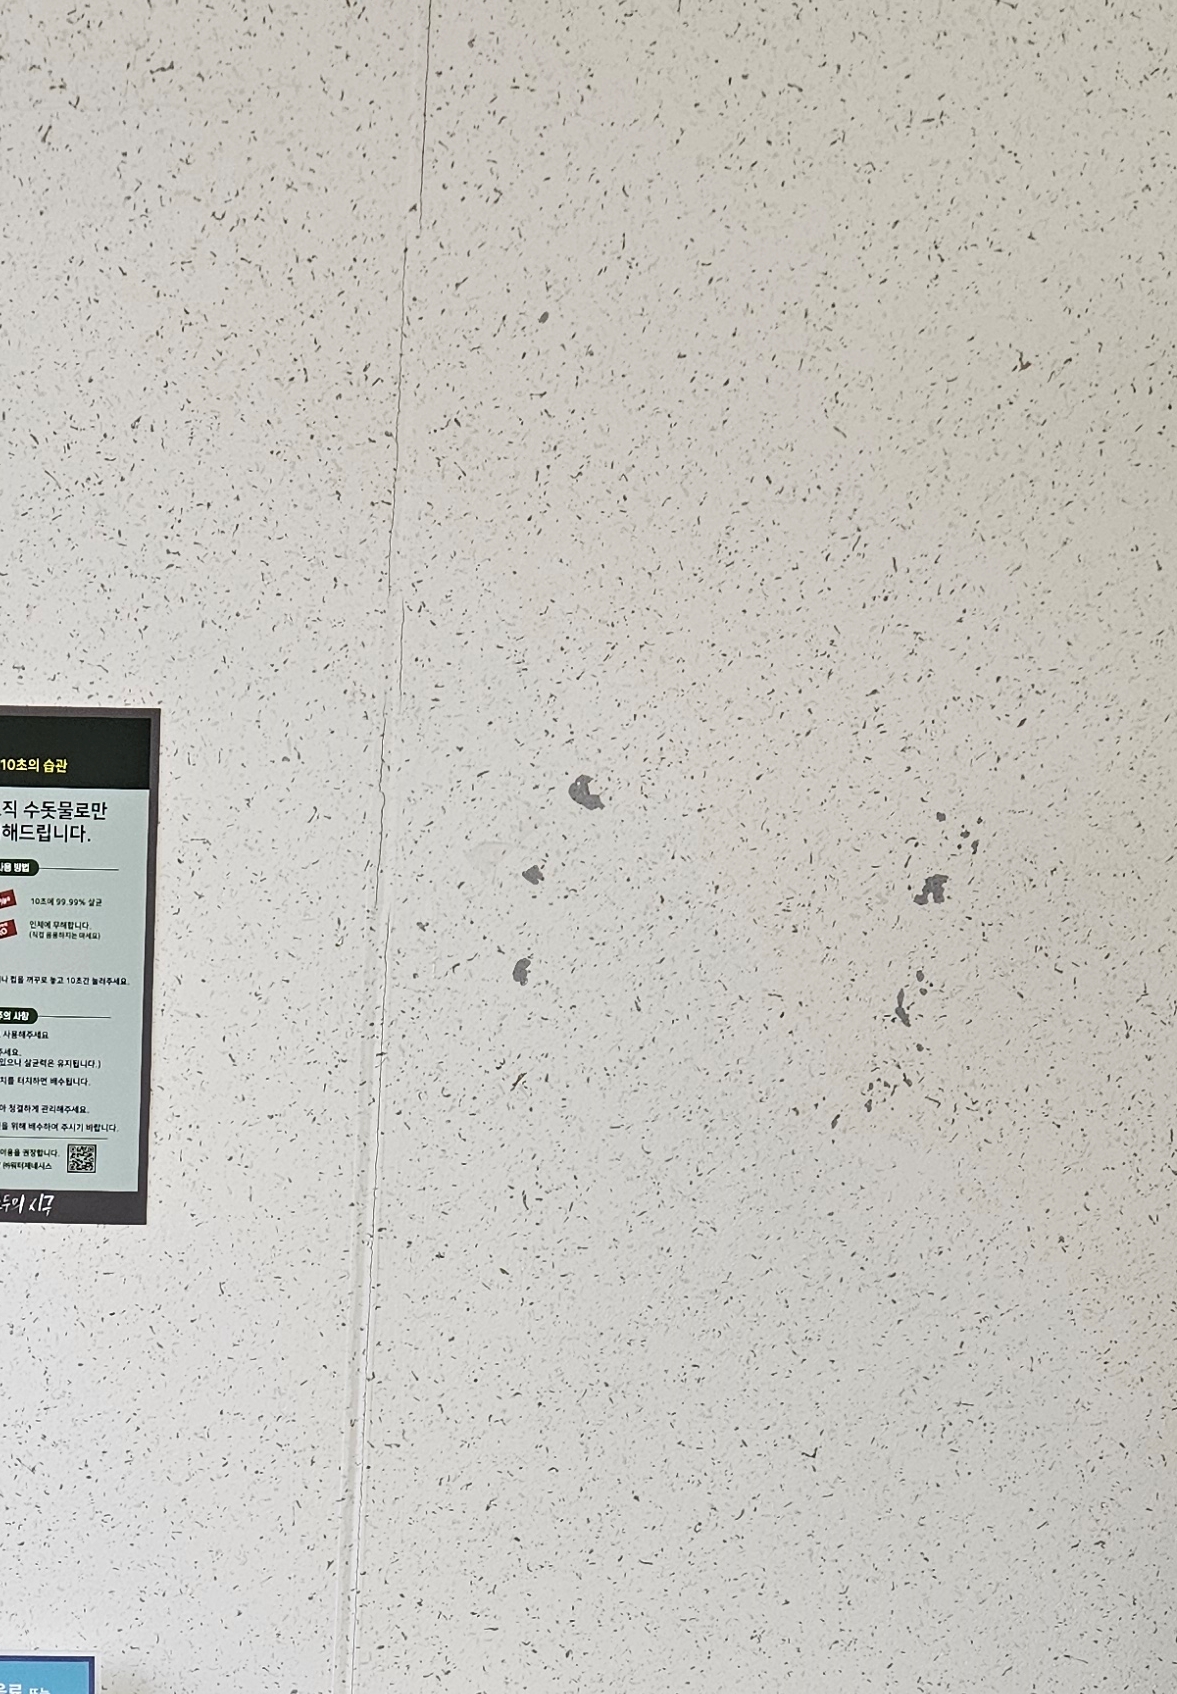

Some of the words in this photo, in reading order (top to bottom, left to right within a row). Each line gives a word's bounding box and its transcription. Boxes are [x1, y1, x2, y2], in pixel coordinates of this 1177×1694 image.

[0, 758, 40, 772] 10초의
[43, 759, 67, 774] 습관
[23, 801, 107, 821] 수돗물로만
[14, 862, 30, 873] 방법
[31, 898, 54, 906] 10초에
[56, 898, 86, 906] 99.99%
[88, 898, 102, 906] 살균
[29, 920, 51, 929] 인체에
[52, 921, 92, 930] 무해합니다.
[79, 932, 101, 940] 마세요)
[10, 975, 24, 984] 컵을
[50, 976, 64, 984] 놓고
[66, 976, 89, 985] 10초간
[92, 977, 130, 985] 눌러주세요.
[13, 1011, 29, 1021] 사항
[0, 1058, 22, 1067] 있으나
[24, 1059, 54, 1067] 살균력은
[57, 1059, 101, 1069] 유지됩니다.)
[17, 1077, 47, 1085] 터치하면
[49, 1077, 91, 1086] 배수됩니다.
[8, 1104, 39, 1113] 청결하게
[41, 1105, 89, 1114] 관리해주세요.
[11, 1122, 26, 1131] 위해
[28, 1123, 58, 1131] 배수하여
[61, 1123, 83, 1132] 주시기
[85, 1124, 119, 1132] 바랍니다.
[0, 1148, 20, 1156] 이용을
[22, 1148, 60, 1157] 권장합니다.
